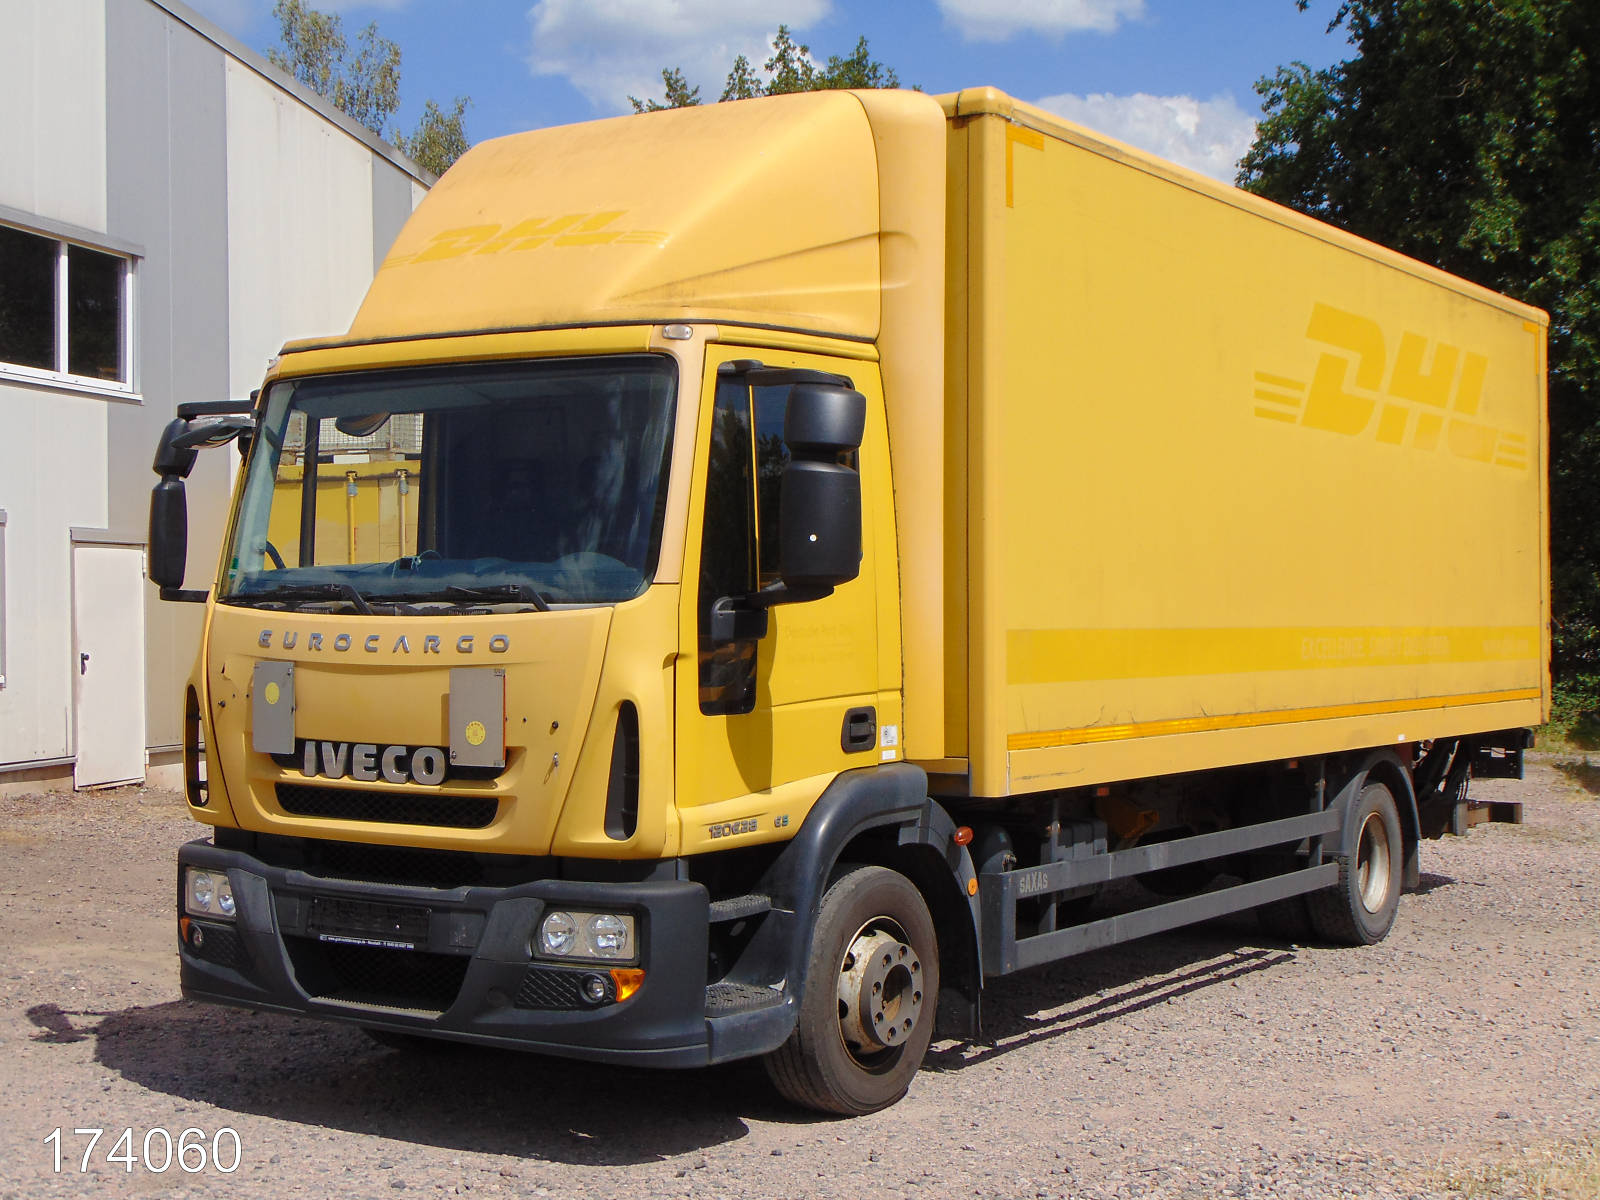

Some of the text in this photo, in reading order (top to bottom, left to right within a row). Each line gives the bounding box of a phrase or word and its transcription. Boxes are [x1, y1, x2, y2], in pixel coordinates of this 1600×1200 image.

[409, 209, 629, 264] DHL
[1301, 302, 1498, 464] DHL
[258, 629, 510, 654] EUROCARGO
[303, 741, 447, 786] IVECO
[1019, 871, 1049, 894] SAXAS
